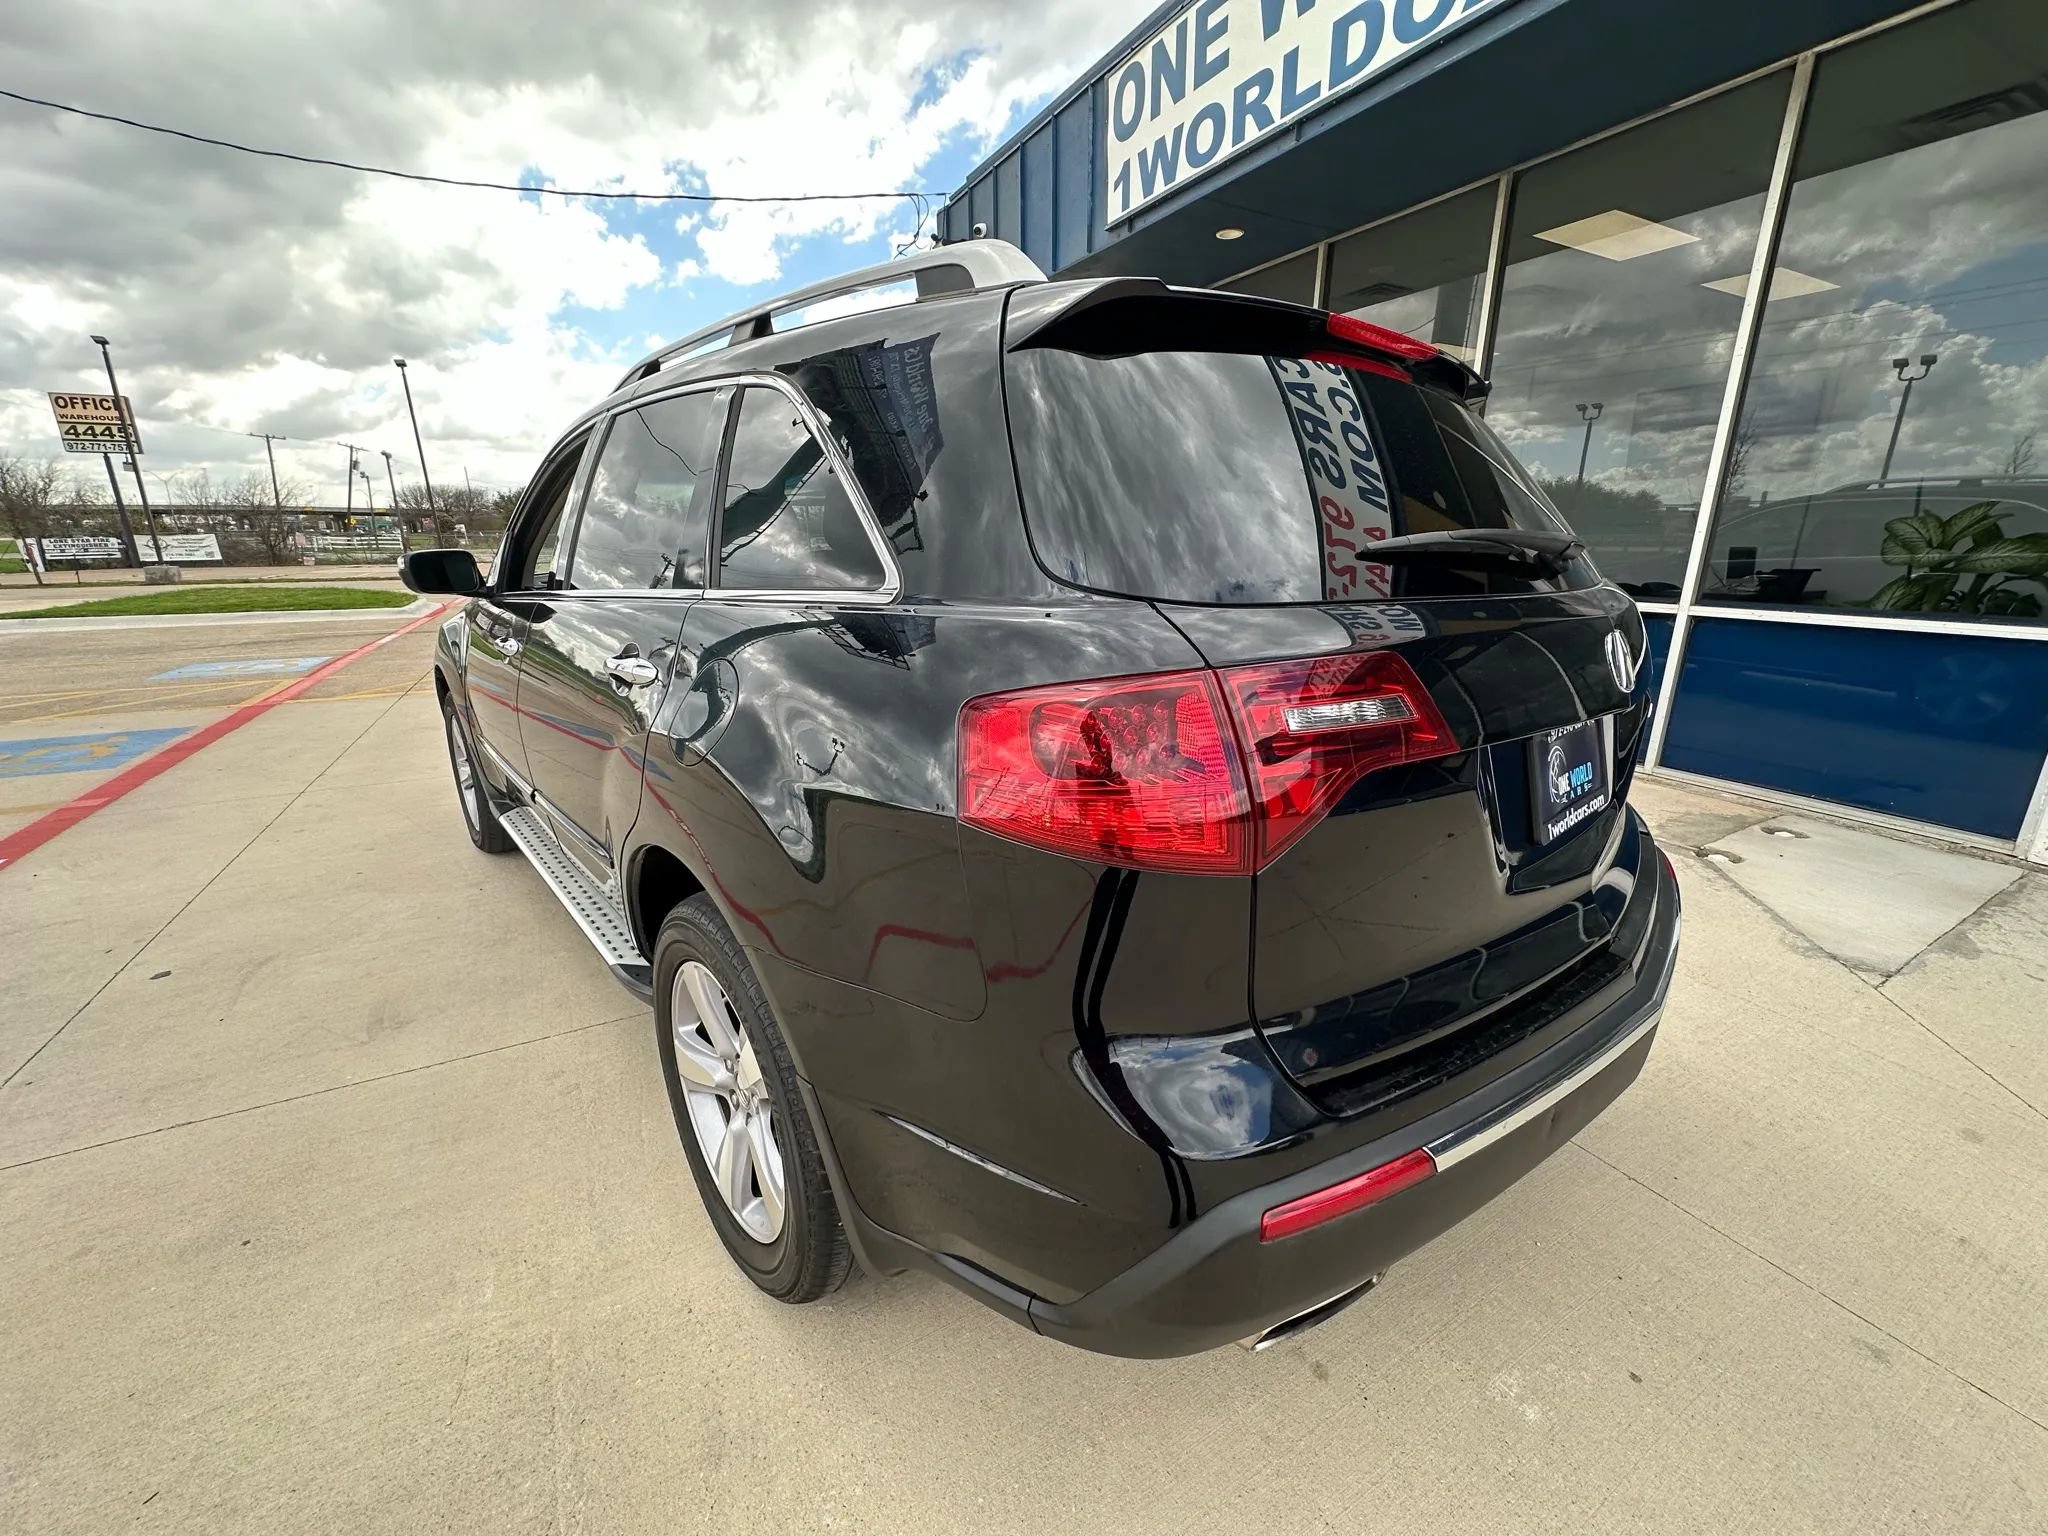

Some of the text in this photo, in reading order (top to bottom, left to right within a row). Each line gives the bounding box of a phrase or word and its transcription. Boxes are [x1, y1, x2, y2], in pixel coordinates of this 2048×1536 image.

[1113, 0, 1229, 142] ONE
[1113, 0, 1486, 213] 1WORLD
[58, 413, 121, 421] WAREHOUS
[64, 425, 133, 439] 4445
[66, 442, 135, 452] 972-771-757
[1558, 761, 1593, 796] ONE WORLD
[1547, 793, 1606, 841] 1worldcars.com
